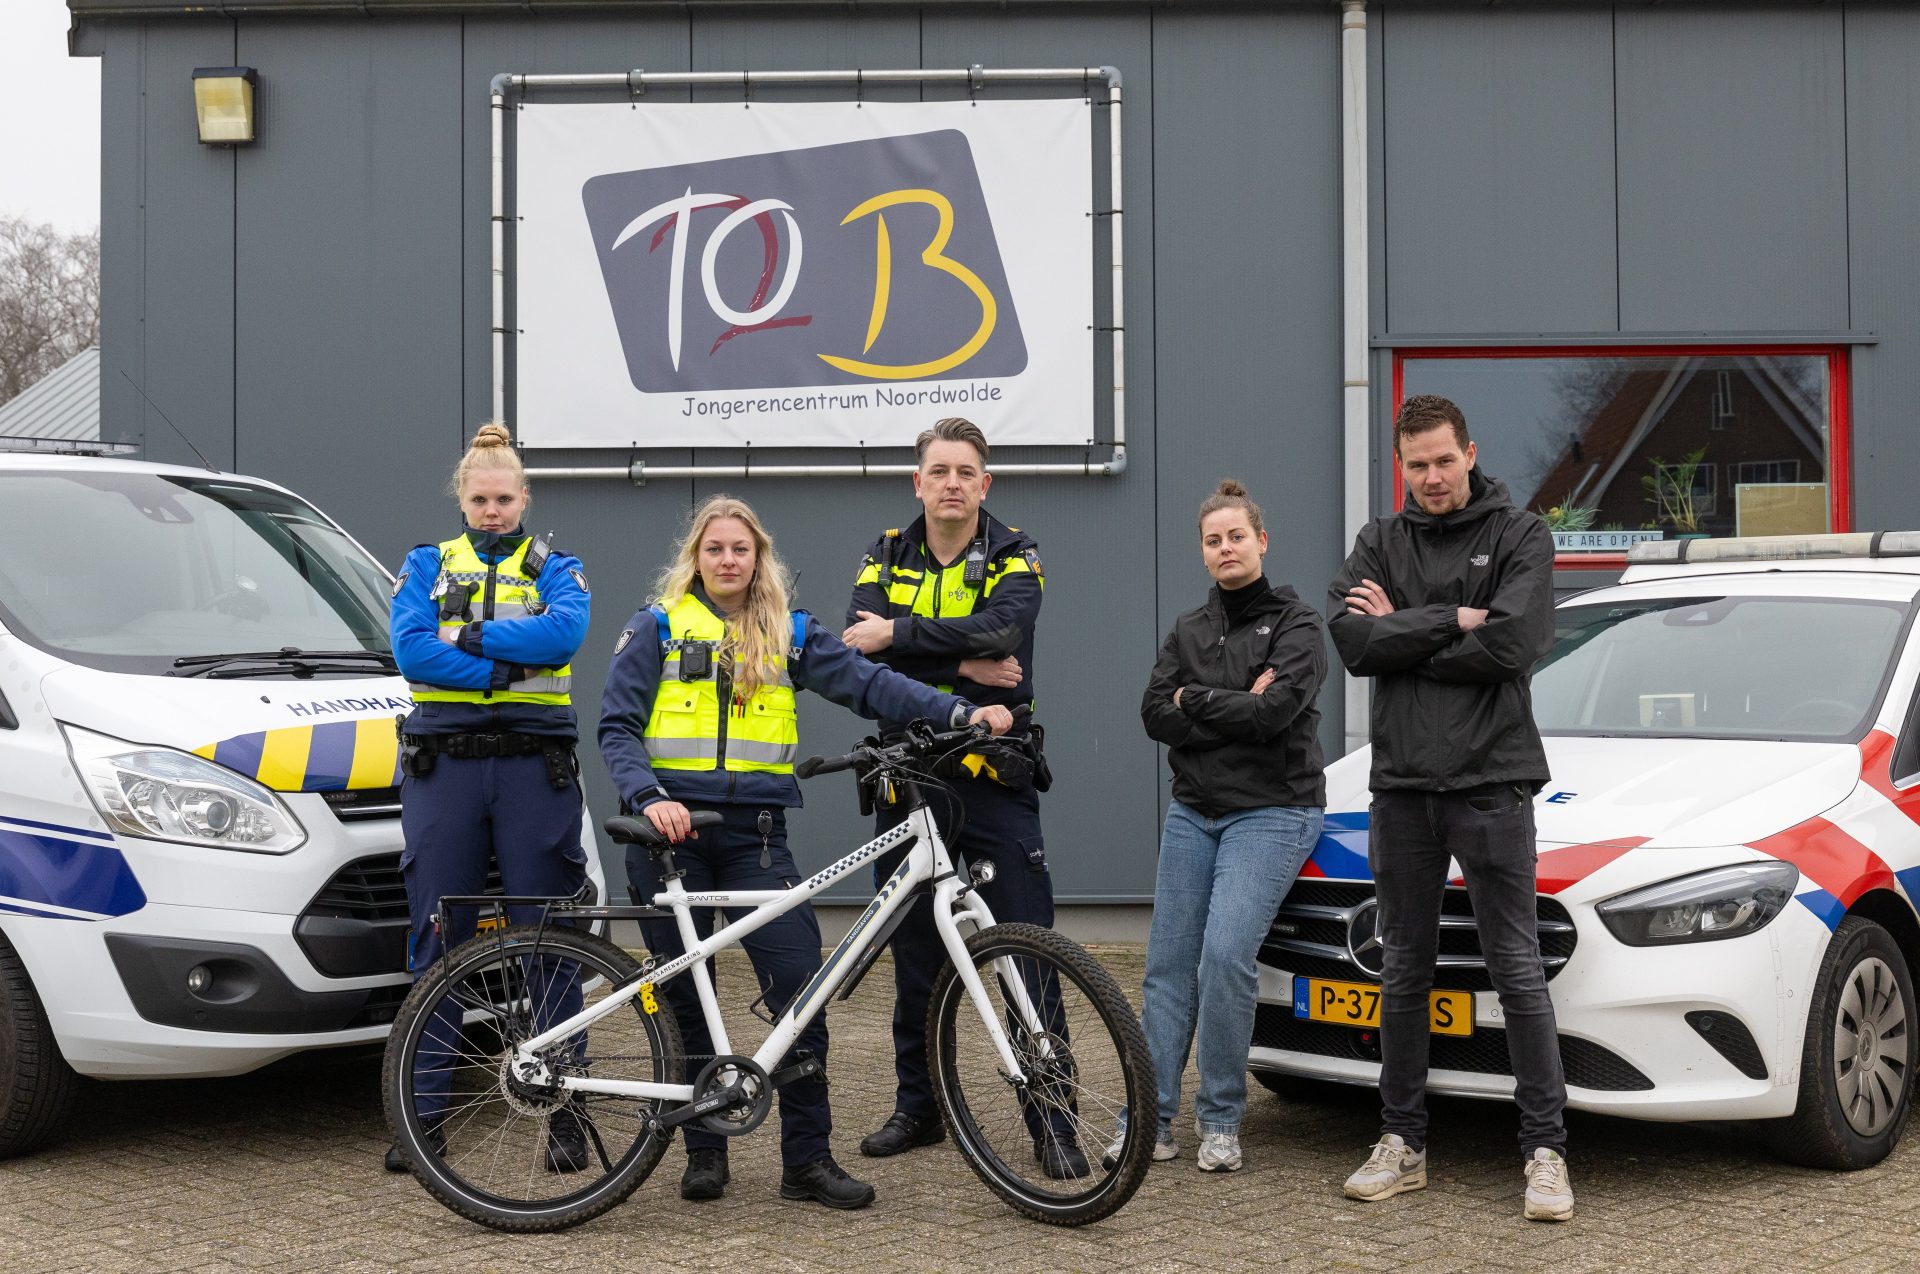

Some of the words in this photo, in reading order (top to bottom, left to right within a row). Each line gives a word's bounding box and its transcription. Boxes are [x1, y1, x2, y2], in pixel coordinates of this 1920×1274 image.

[682, 392, 868, 420] Jongerencentrum
[875, 382, 1003, 408] Noordwolde
[1558, 535, 1573, 547] WE
[1580, 535, 1602, 547] ARE
[286, 696, 418, 716] HANDHAV
[846, 909, 875, 945] HANDHAVING
[1296, 1001, 1309, 1012] NL
